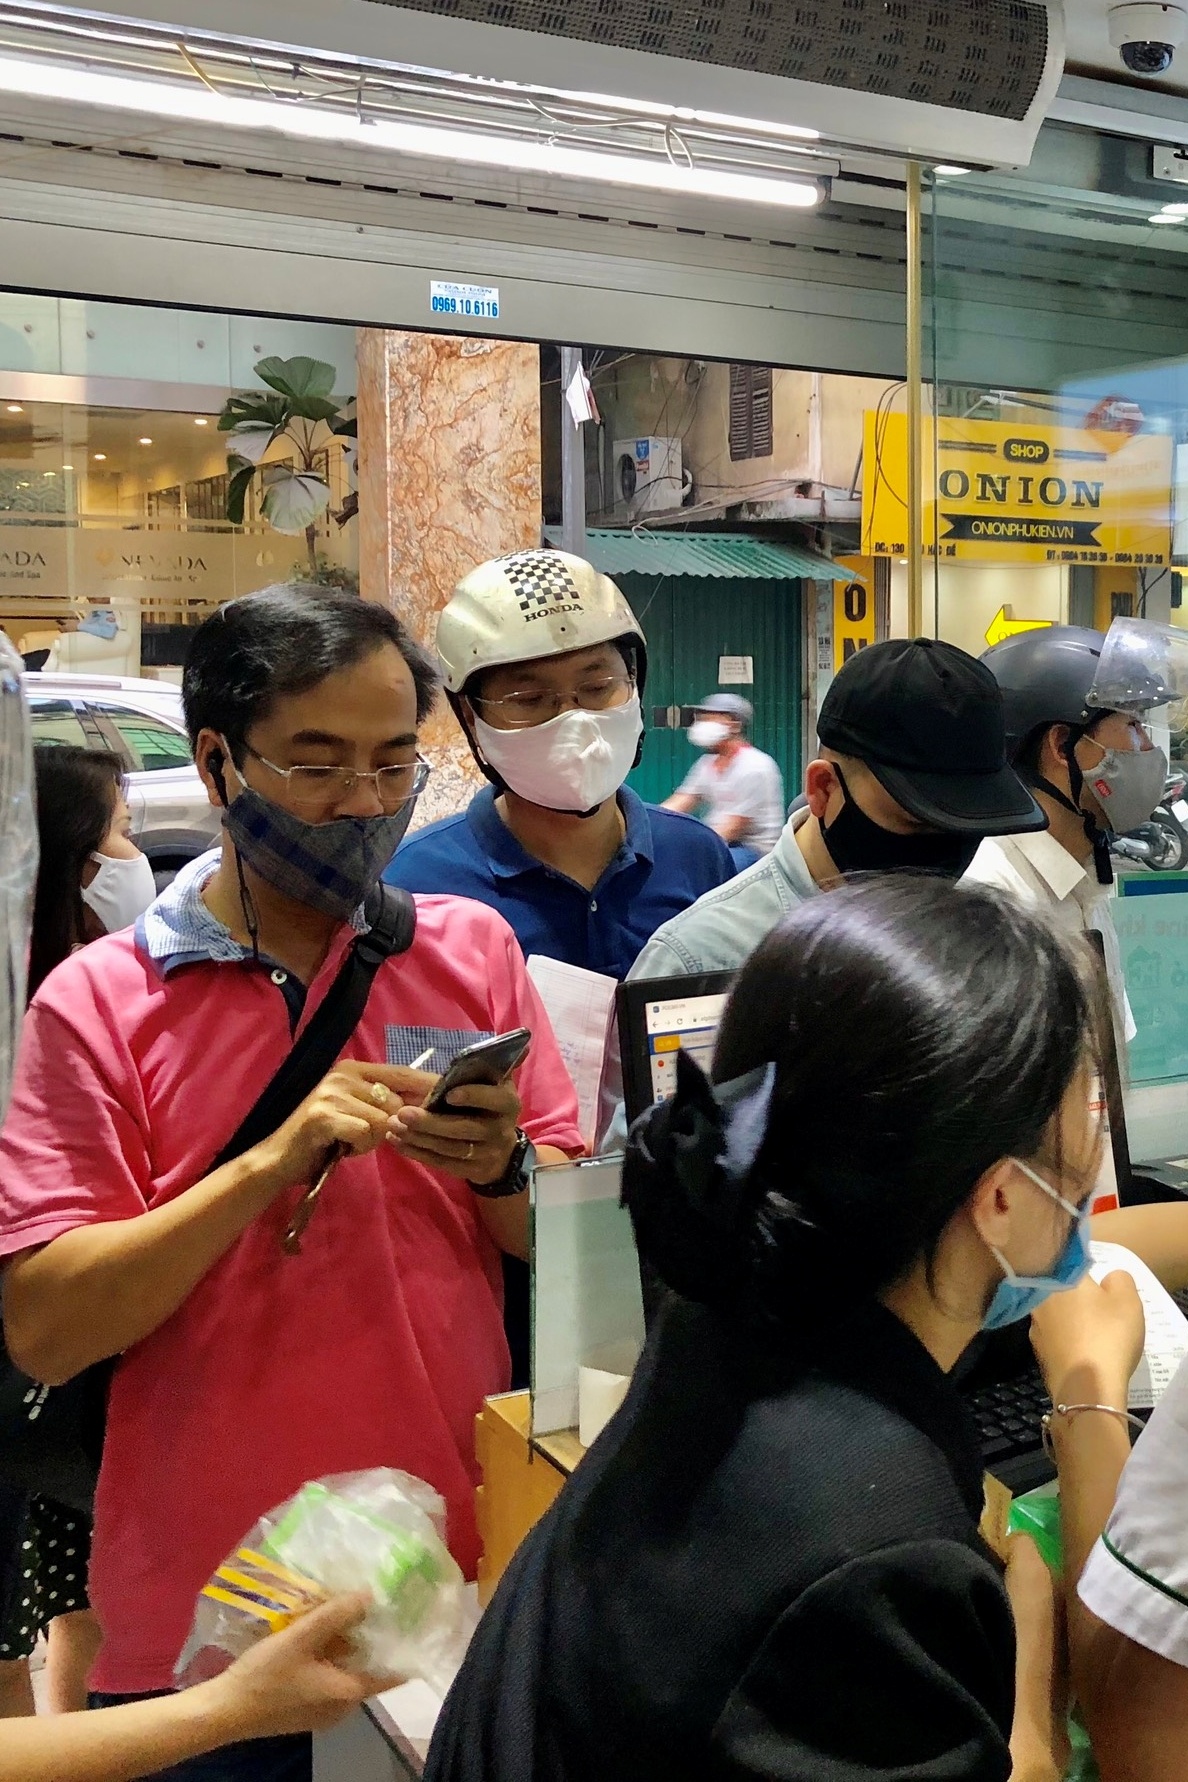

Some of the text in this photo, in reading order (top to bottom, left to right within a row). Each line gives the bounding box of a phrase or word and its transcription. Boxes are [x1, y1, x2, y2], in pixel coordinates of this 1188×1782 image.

[432, 296, 498, 317] 0969.10.6116
[1010, 443, 1044, 459] SHOP
[938, 469, 1104, 508] ONION
[971, 520, 1075, 539] ONIONPHUKIEN.VN
[524, 603, 584, 622] HONDA
